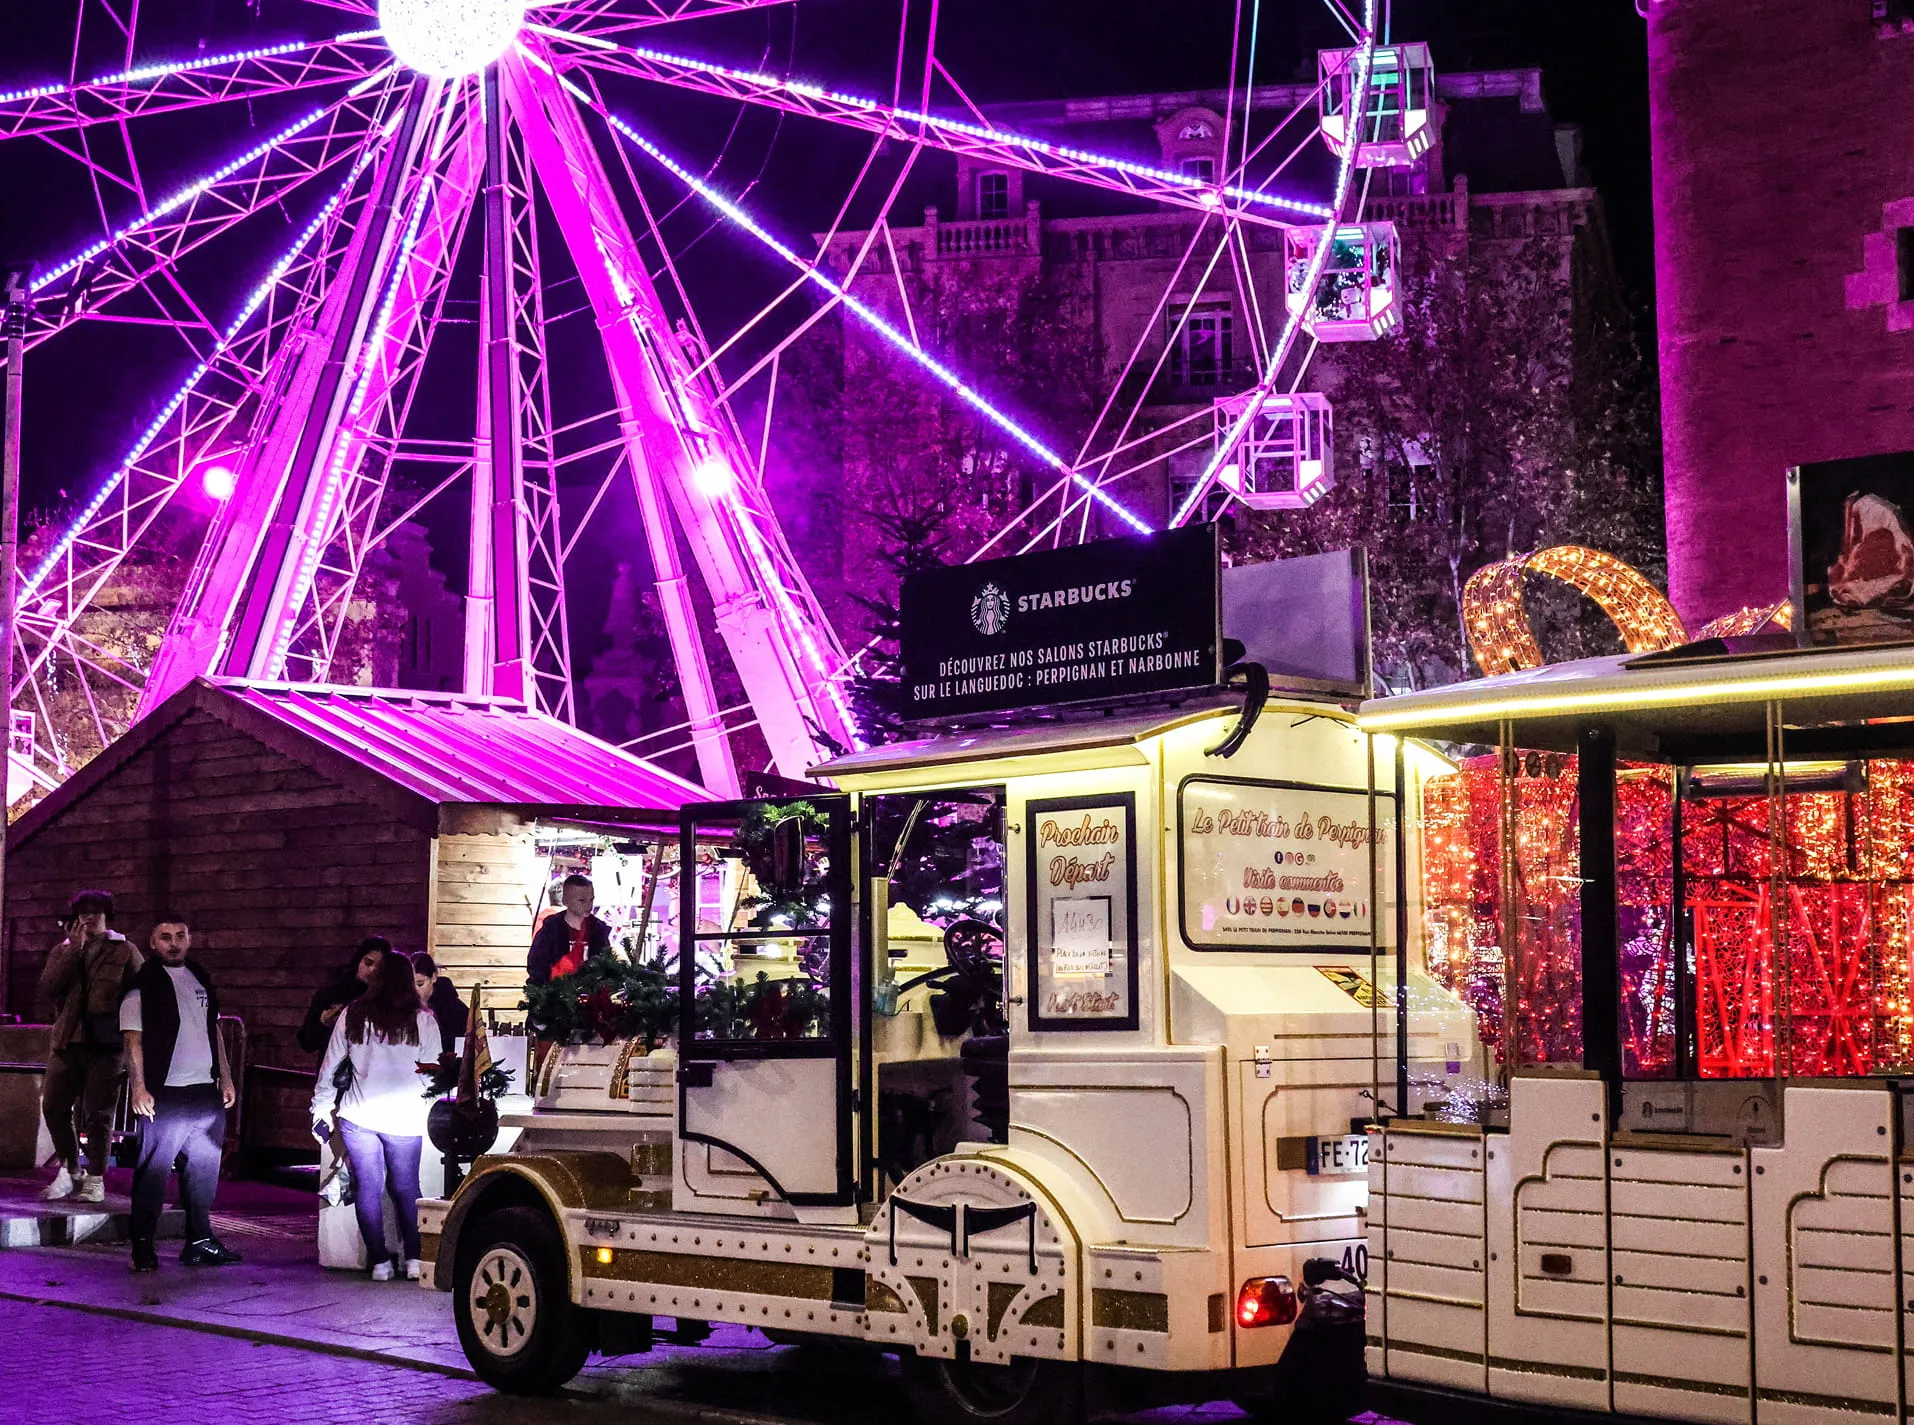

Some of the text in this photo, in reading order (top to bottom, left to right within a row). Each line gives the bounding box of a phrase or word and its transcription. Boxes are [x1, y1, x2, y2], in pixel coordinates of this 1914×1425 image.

[913, 682, 936, 702] SUR
[939, 681, 951, 698] LE
[954, 673, 1024, 696] LANGUEDOC
[1036, 663, 1106, 686] PERPIGNAN
[1110, 659, 1124, 676] ET
[1128, 649, 1201, 675] NARBONNE
[939, 655, 1006, 678] DÉCOUVREZ
[1010, 649, 1034, 668] NOS
[1037, 643, 1085, 665] SALONS
[1040, 813, 1119, 848] Prochain
[1191, 807, 1213, 834] Le
[1217, 808, 1254, 836] Petit
[1254, 809, 1290, 838] train
[1294, 811, 1313, 840] de
[1049, 851, 1115, 890] Départ
[1243, 866, 1345, 893] Visite commentée
